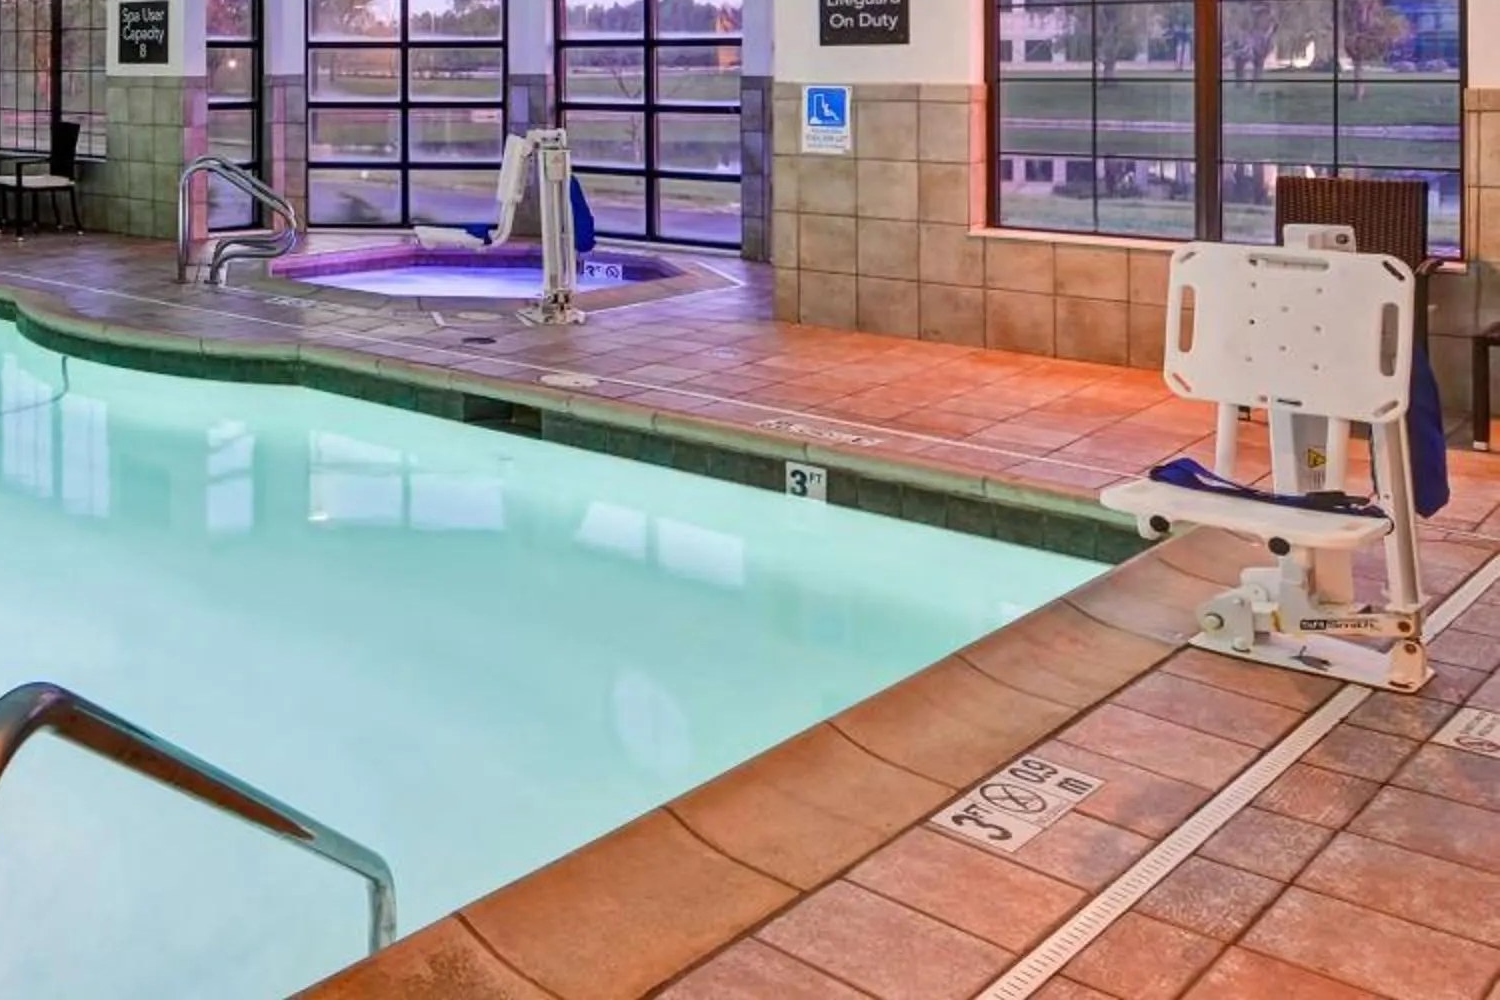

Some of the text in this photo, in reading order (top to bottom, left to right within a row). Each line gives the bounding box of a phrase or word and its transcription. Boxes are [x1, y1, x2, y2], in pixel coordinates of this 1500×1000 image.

[122, 7, 164, 27] Spa User
[829, 12, 899, 30] On Duty
[122, 25, 164, 44] Capacity
[140, 43, 147, 58] 8
[1056, 777, 1093, 796] m
